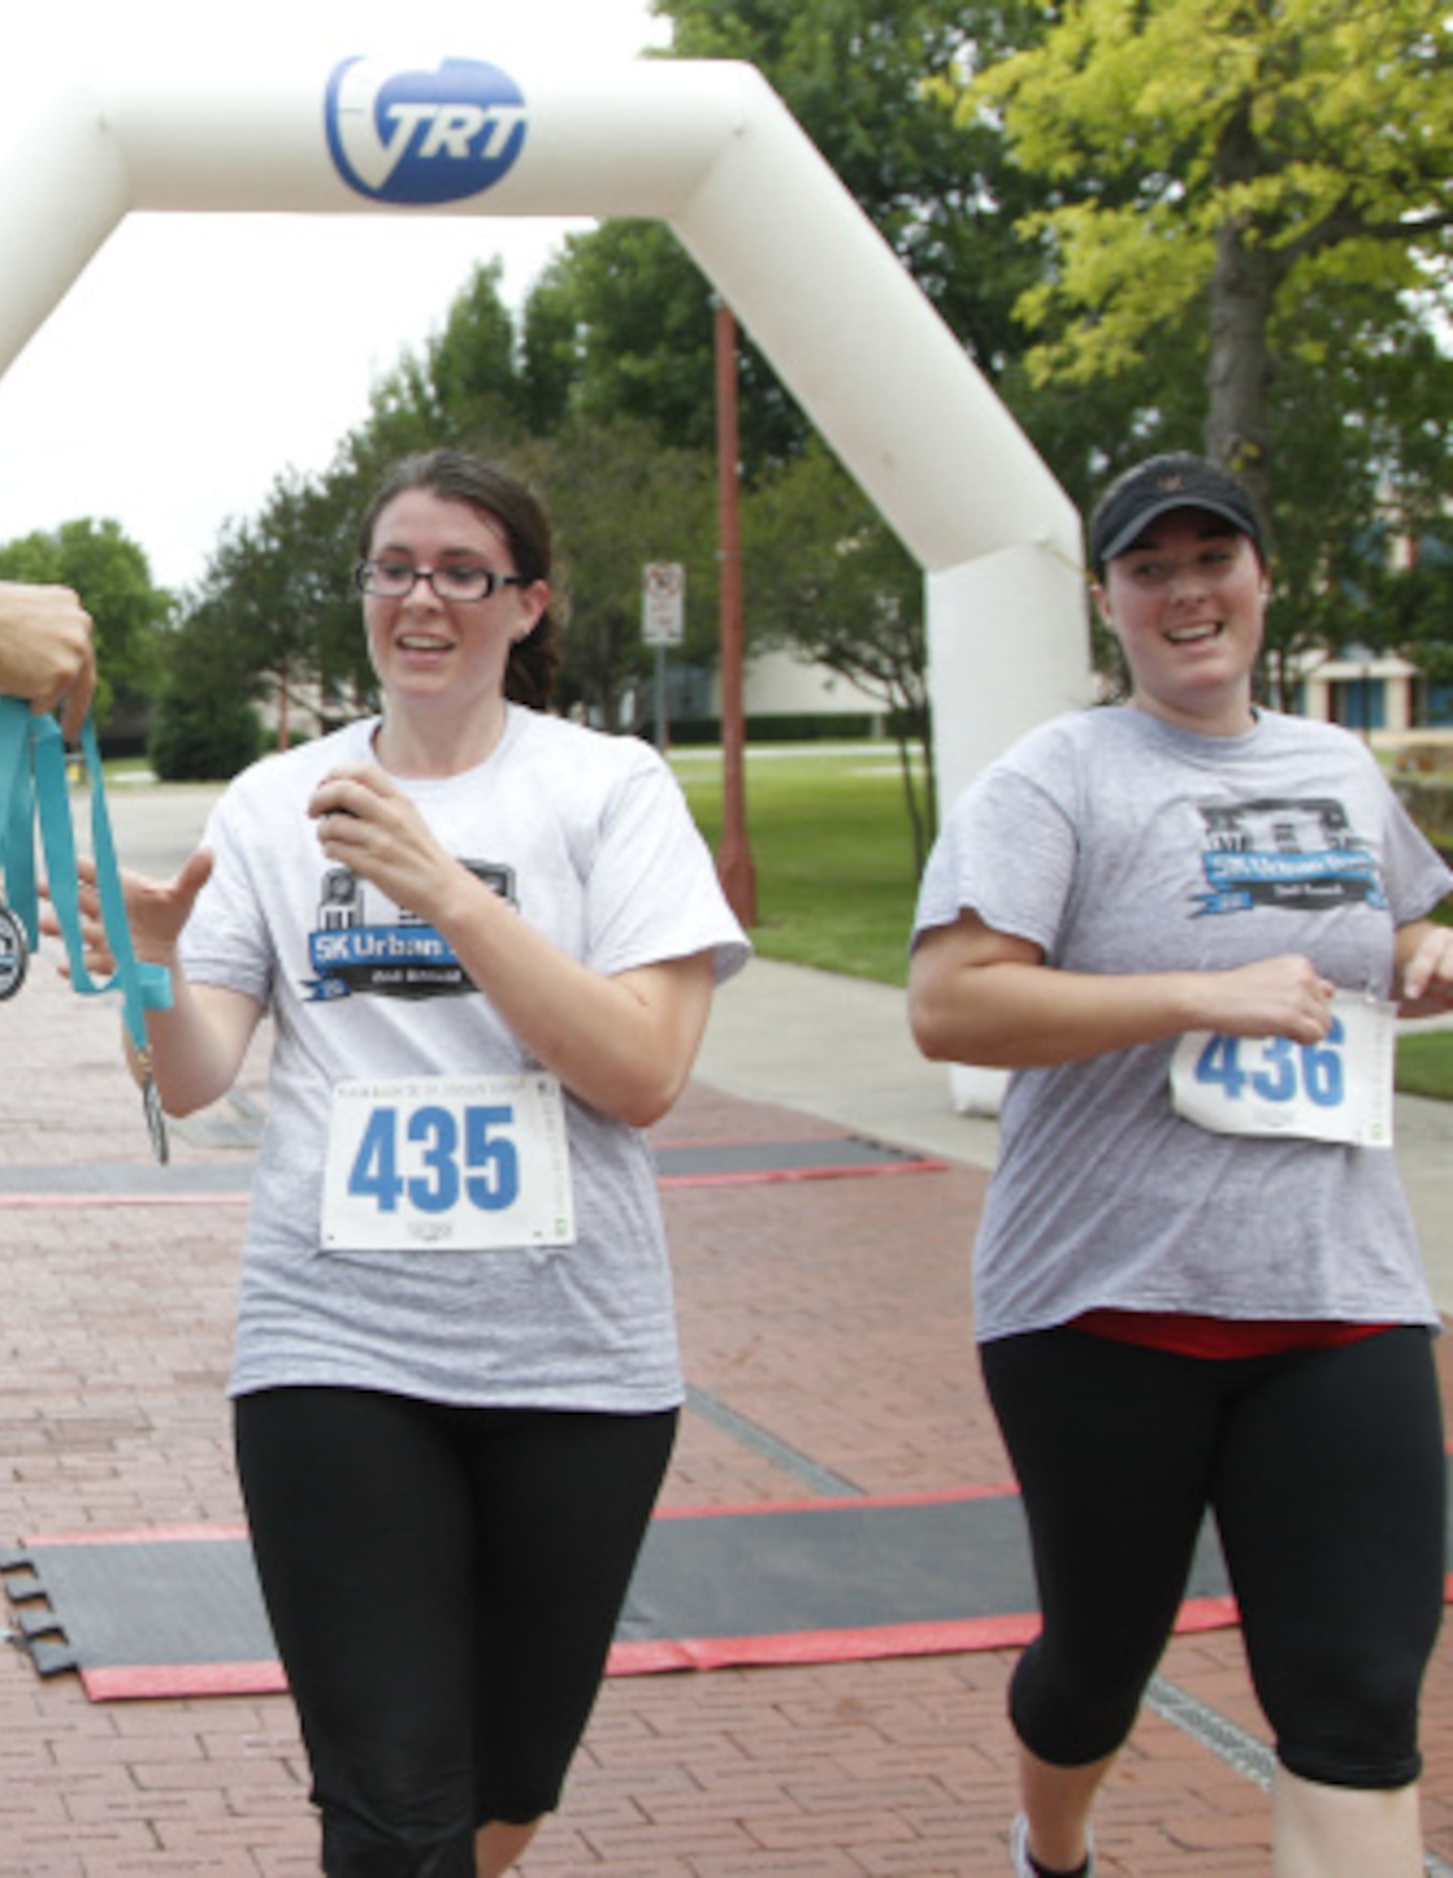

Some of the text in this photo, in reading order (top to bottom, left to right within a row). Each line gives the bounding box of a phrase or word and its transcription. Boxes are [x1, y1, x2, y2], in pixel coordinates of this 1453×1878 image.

[387, 103, 527, 158] TRT
[353, 931, 443, 957] Urban
[1194, 1014, 1346, 1106] 436
[346, 1105, 521, 1213] 435
